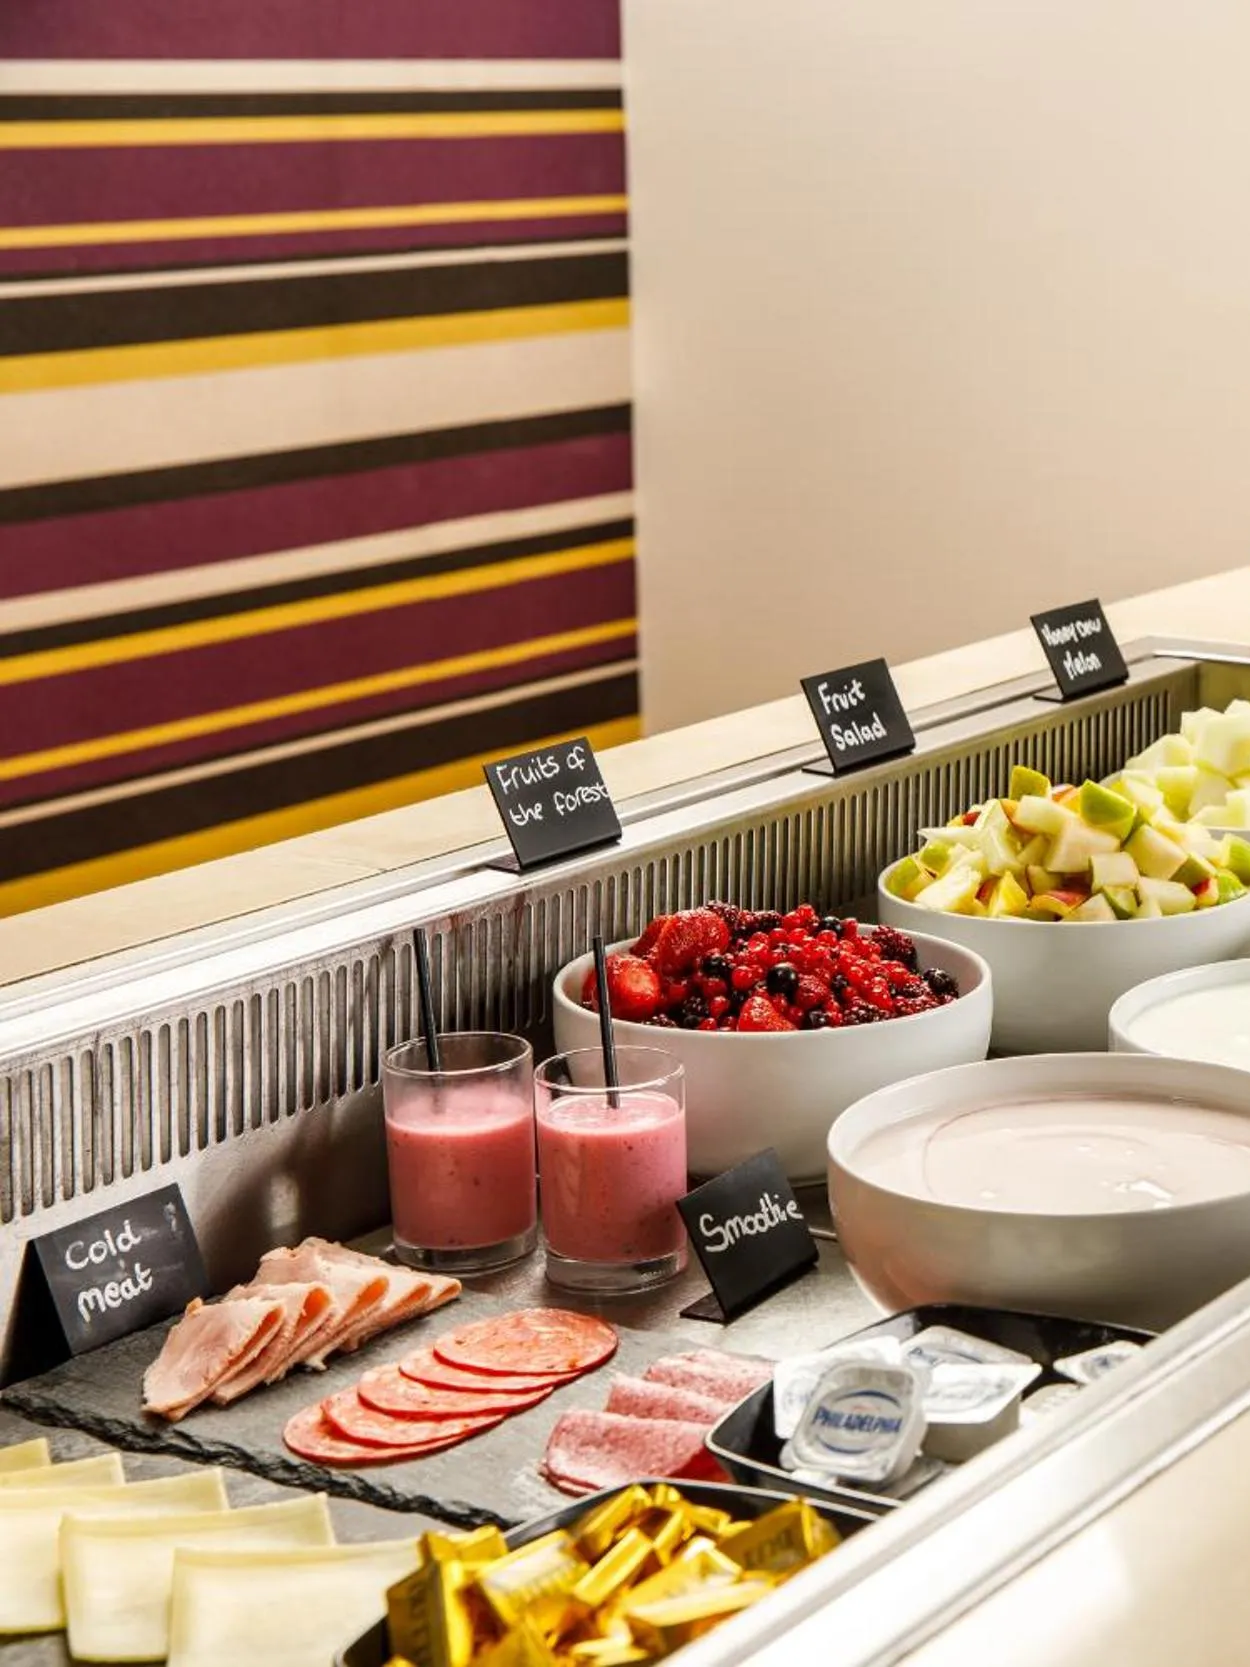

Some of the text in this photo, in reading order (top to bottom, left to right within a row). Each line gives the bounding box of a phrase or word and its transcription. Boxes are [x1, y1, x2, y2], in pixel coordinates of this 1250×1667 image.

[1063, 650, 1102, 680] Melon
[818, 678, 866, 715] Fruit
[830, 711, 888, 751] Salad
[496, 746, 585, 795] Fruits of
[509, 803, 543, 826] the
[699, 1192, 804, 1252] Smoothie
[65, 1219, 142, 1270] Cold
[812, 1406, 903, 1433] PHILADELPHIA
